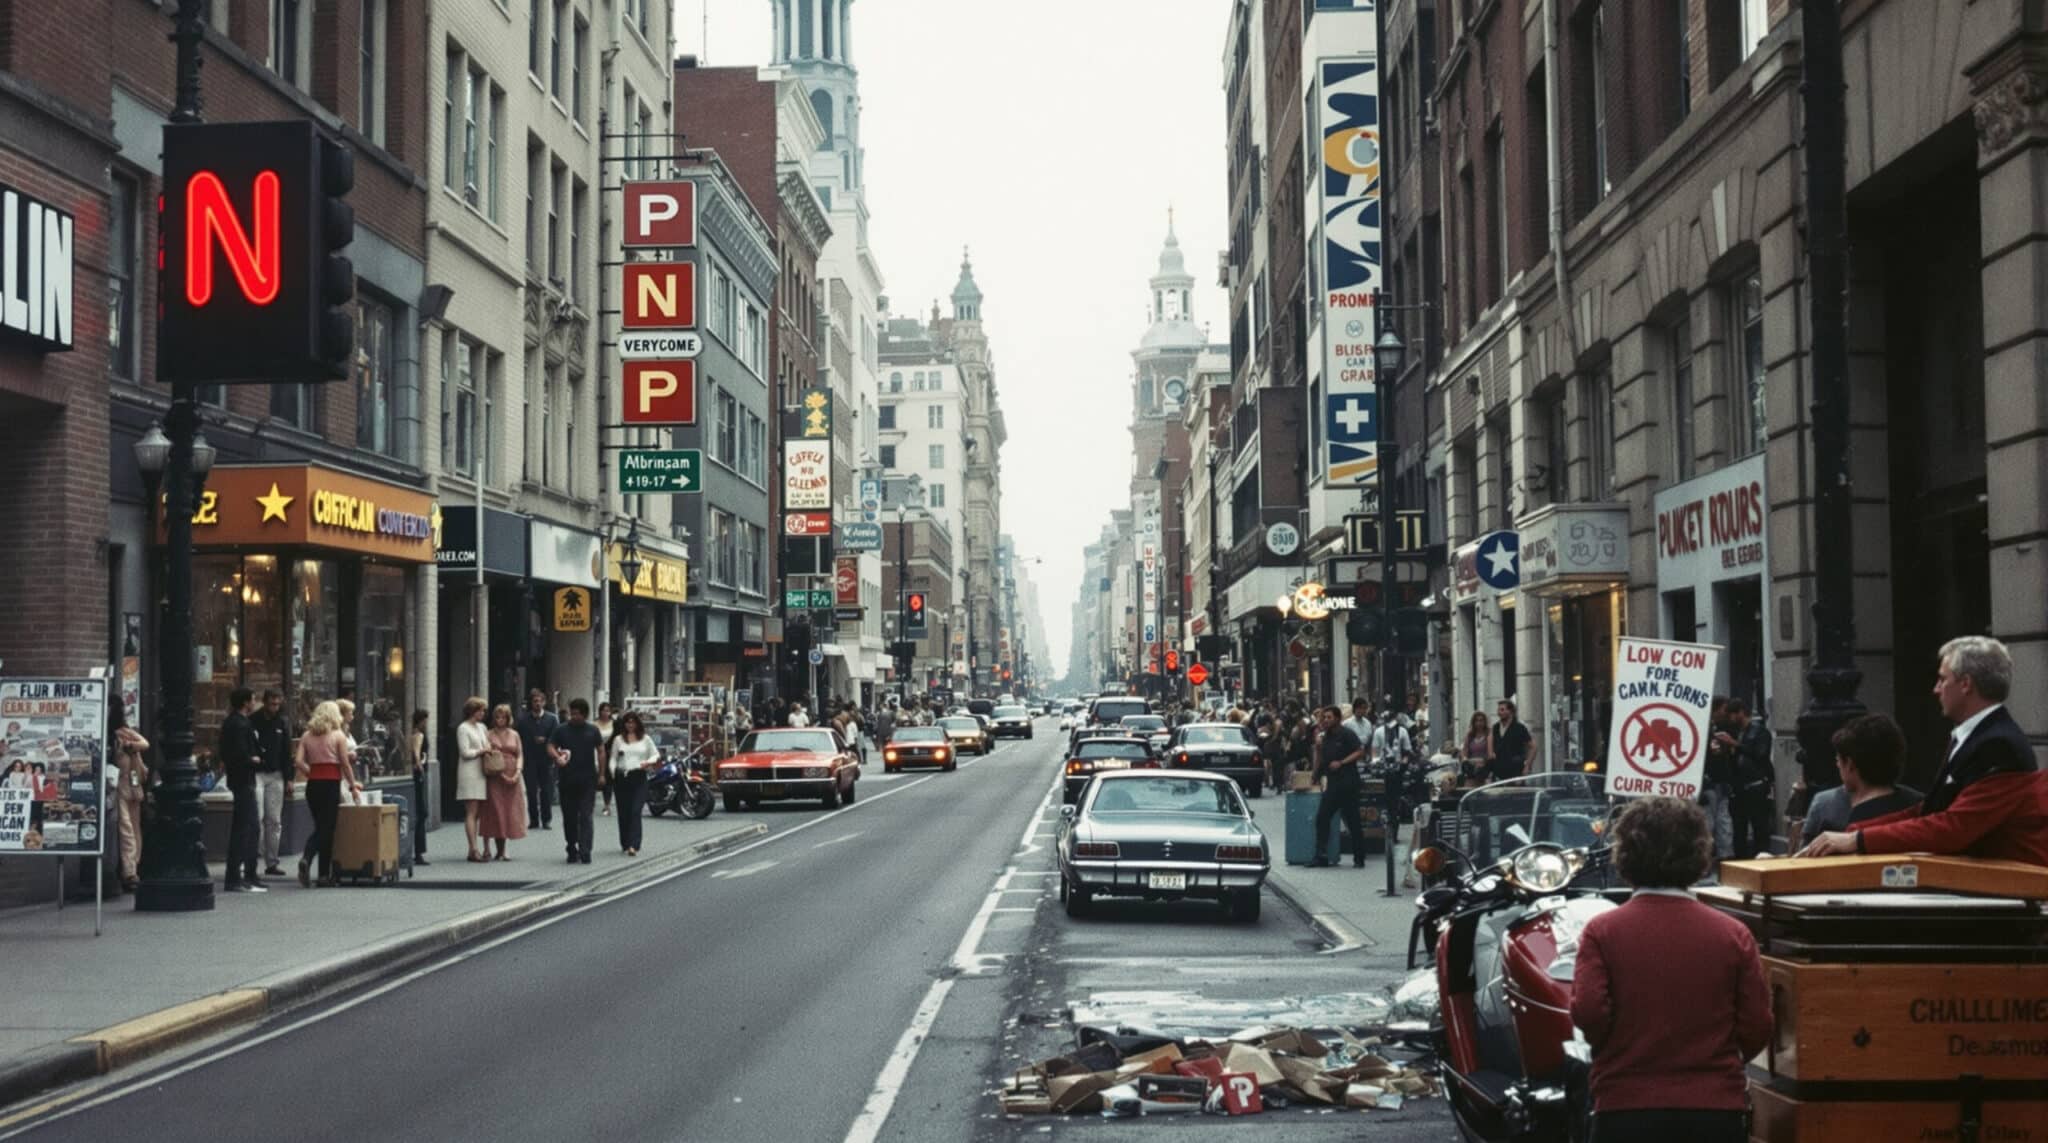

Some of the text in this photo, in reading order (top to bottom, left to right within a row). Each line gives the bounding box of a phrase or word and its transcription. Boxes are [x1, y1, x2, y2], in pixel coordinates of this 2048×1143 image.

[639, 194, 679, 236] P
[186, 169, 281, 307] N
[0, 190, 73, 345] LIN
[637, 274, 677, 317] N
[624, 339, 695, 351] VERYCOME
[639, 370, 678, 413] P
[1627, 645, 1706, 670] LOW CON
[1646, 666, 1680, 682] FORE
[1665, 682, 1710, 709] FORNS
[1614, 776, 1696, 799] CURR STOP
